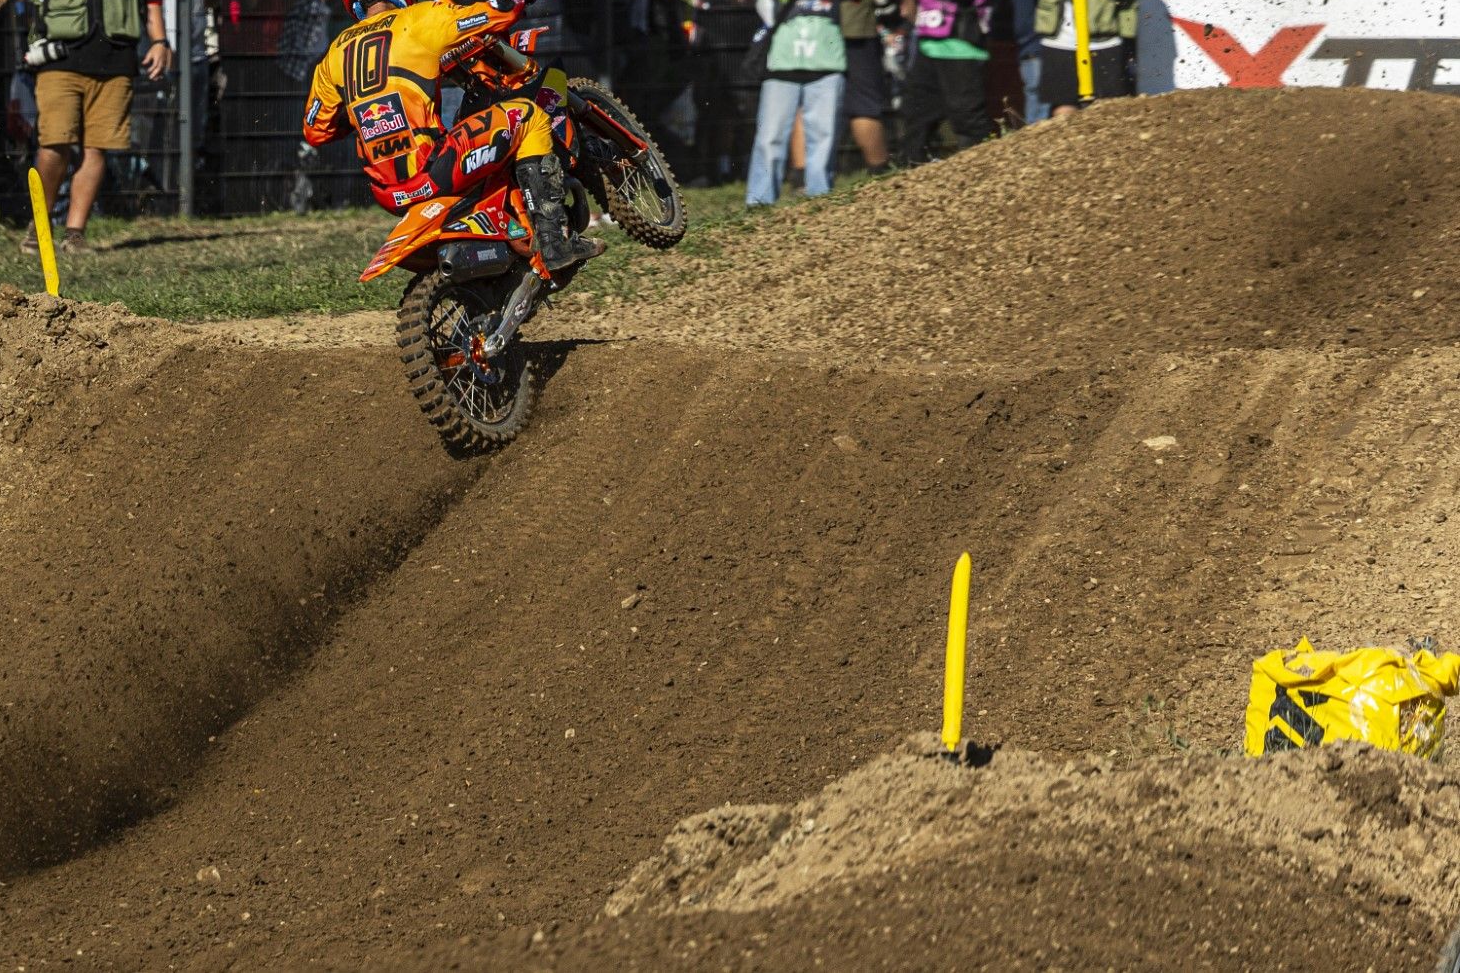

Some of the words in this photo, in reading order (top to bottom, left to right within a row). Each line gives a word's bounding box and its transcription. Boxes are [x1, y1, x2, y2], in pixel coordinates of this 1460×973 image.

[343, 30, 393, 103] 10
[361, 121, 381, 140] Red
[380, 114, 405, 132] Bull
[451, 111, 492, 147] FLY
[371, 135, 411, 159] KTM
[466, 145, 497, 174] KTM
[395, 183, 430, 202] BELGIUM
